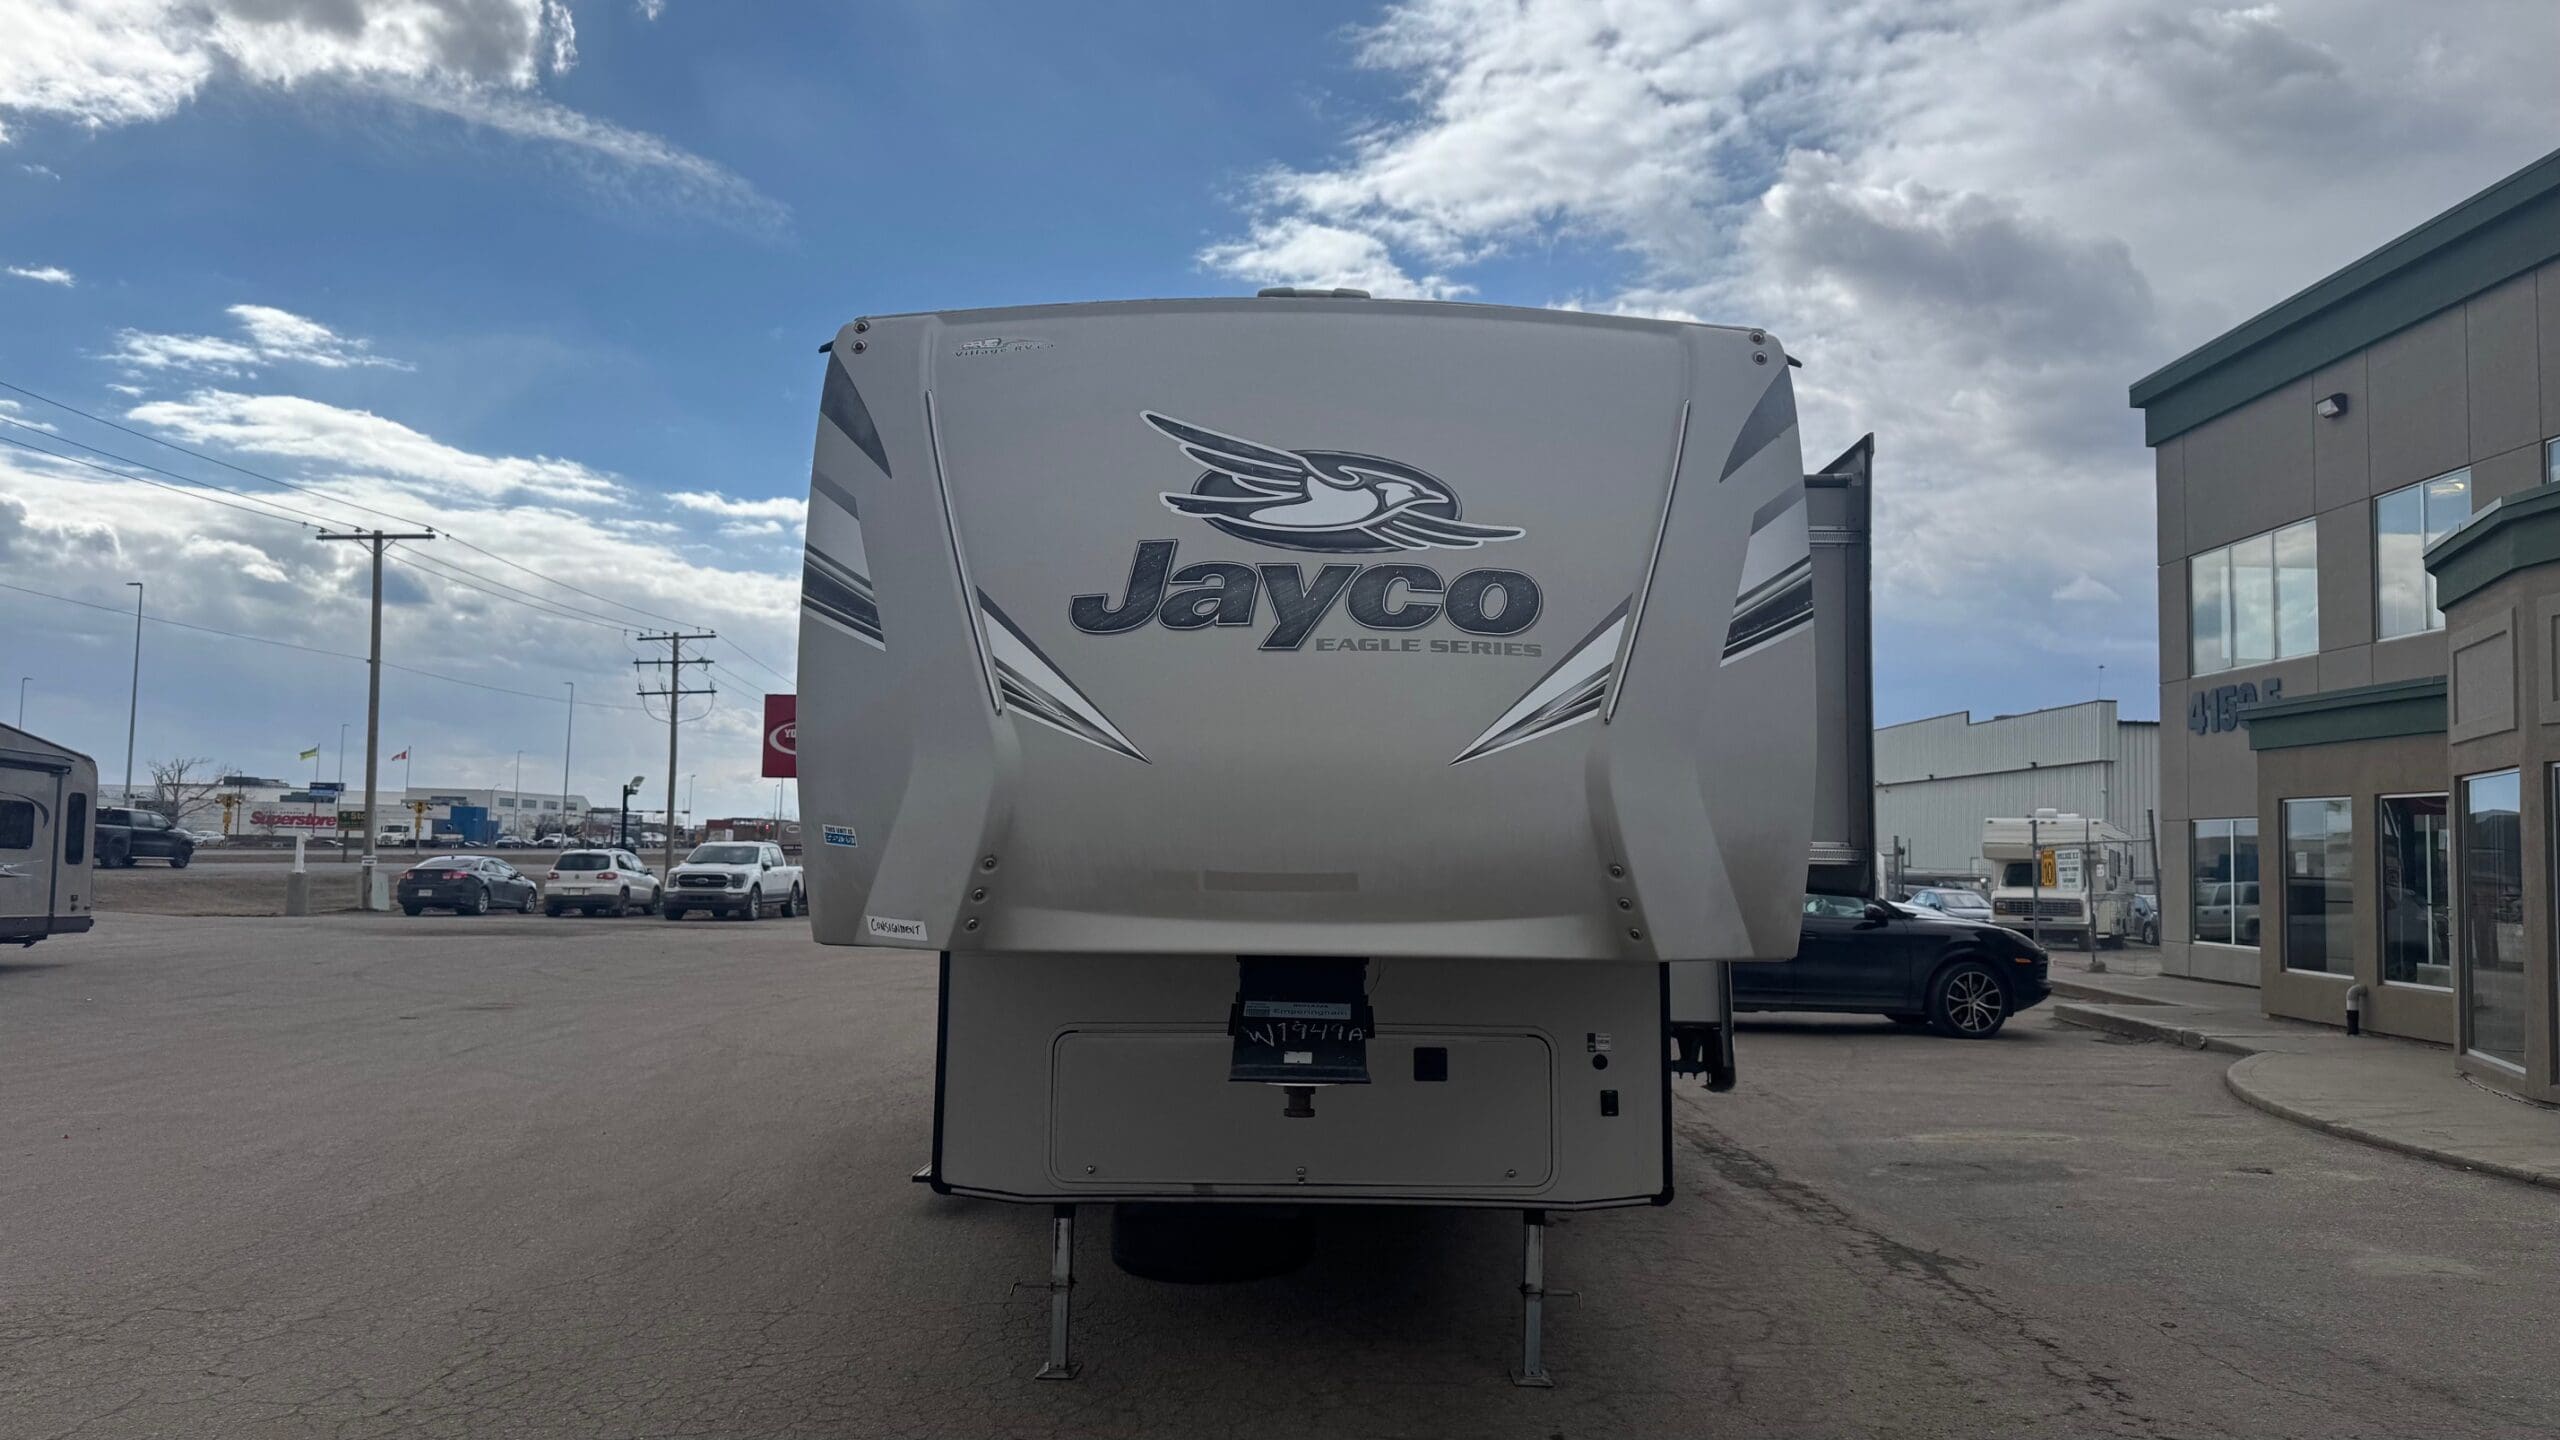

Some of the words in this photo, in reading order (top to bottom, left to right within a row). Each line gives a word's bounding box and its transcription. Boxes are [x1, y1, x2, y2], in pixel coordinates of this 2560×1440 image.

[1069, 538, 1543, 652] Jayco
[1316, 638, 1421, 652] EAGLE
[1430, 639, 1542, 657] SERIES
[249, 811, 336, 826] Superstore
